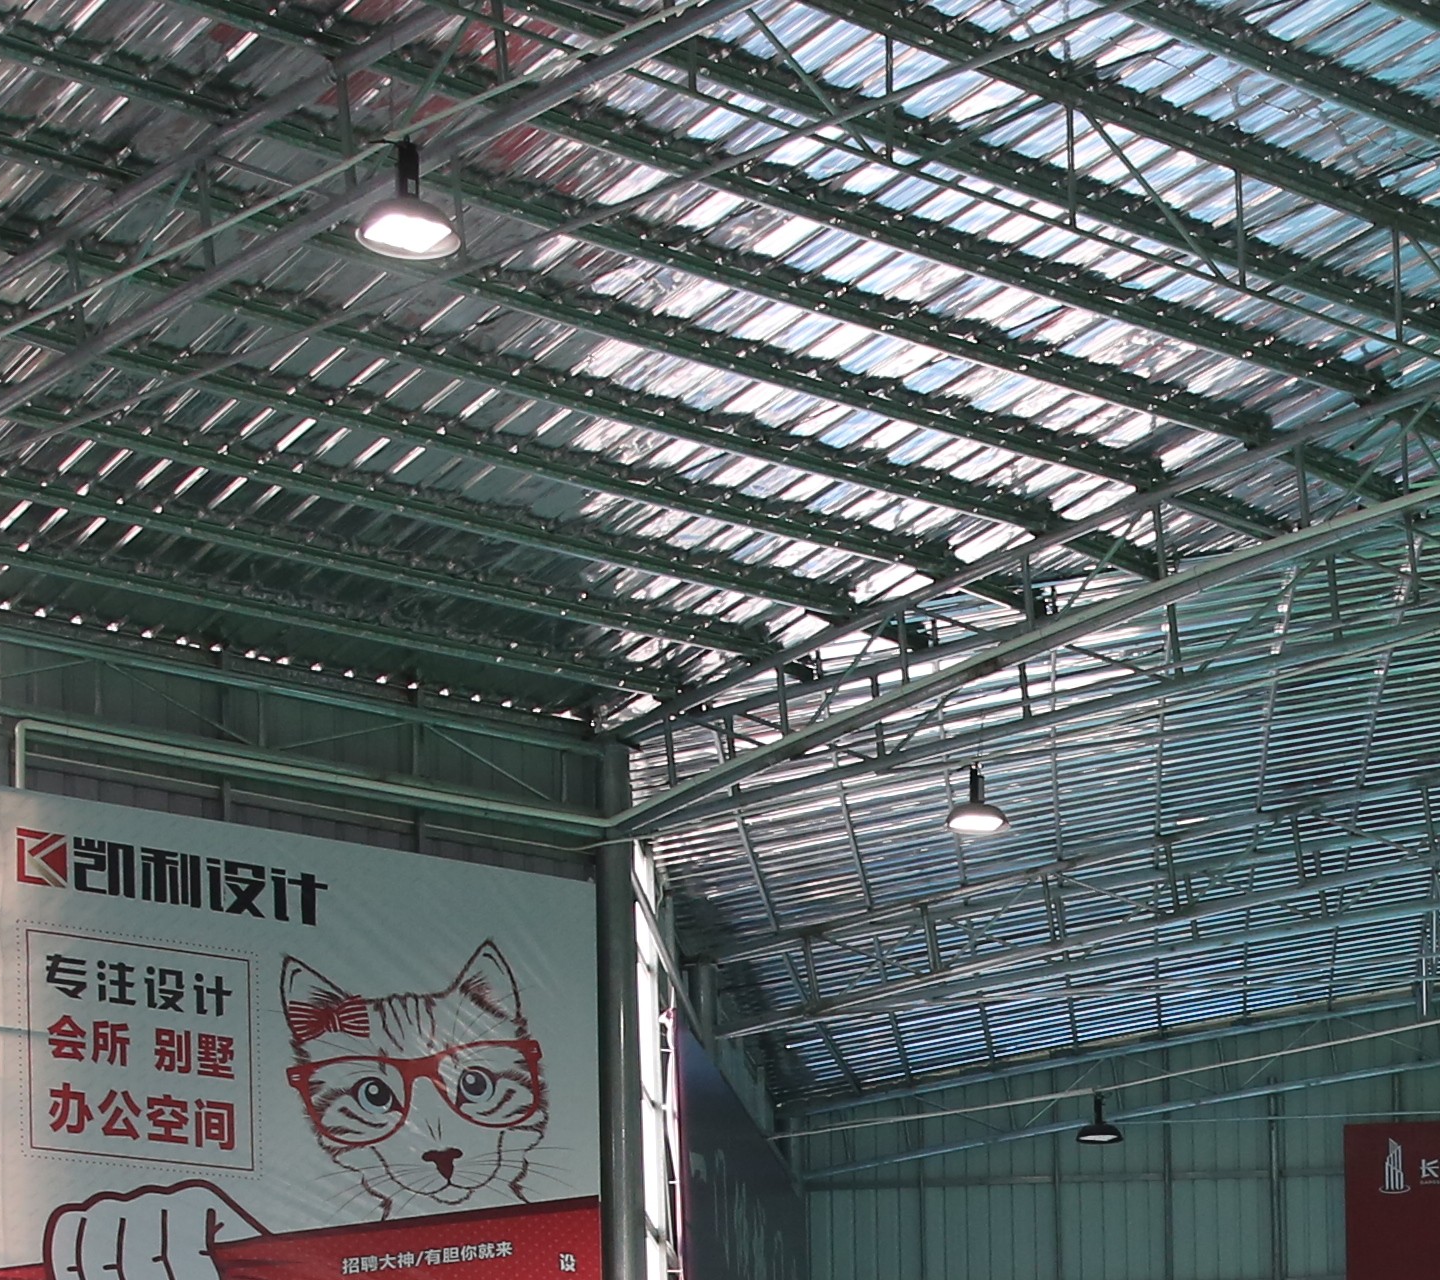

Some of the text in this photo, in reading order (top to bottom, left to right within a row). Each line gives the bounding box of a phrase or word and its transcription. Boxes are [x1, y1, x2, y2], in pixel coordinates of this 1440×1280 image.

[73, 836, 328, 925] 凯利设计
[45, 953, 232, 1017] 专注设计
[47, 1014, 235, 1080] 会所 别墅
[48, 1081, 235, 1150] 办公空间
[342, 1239, 512, 1275] 招聘大神/有胆你就来
